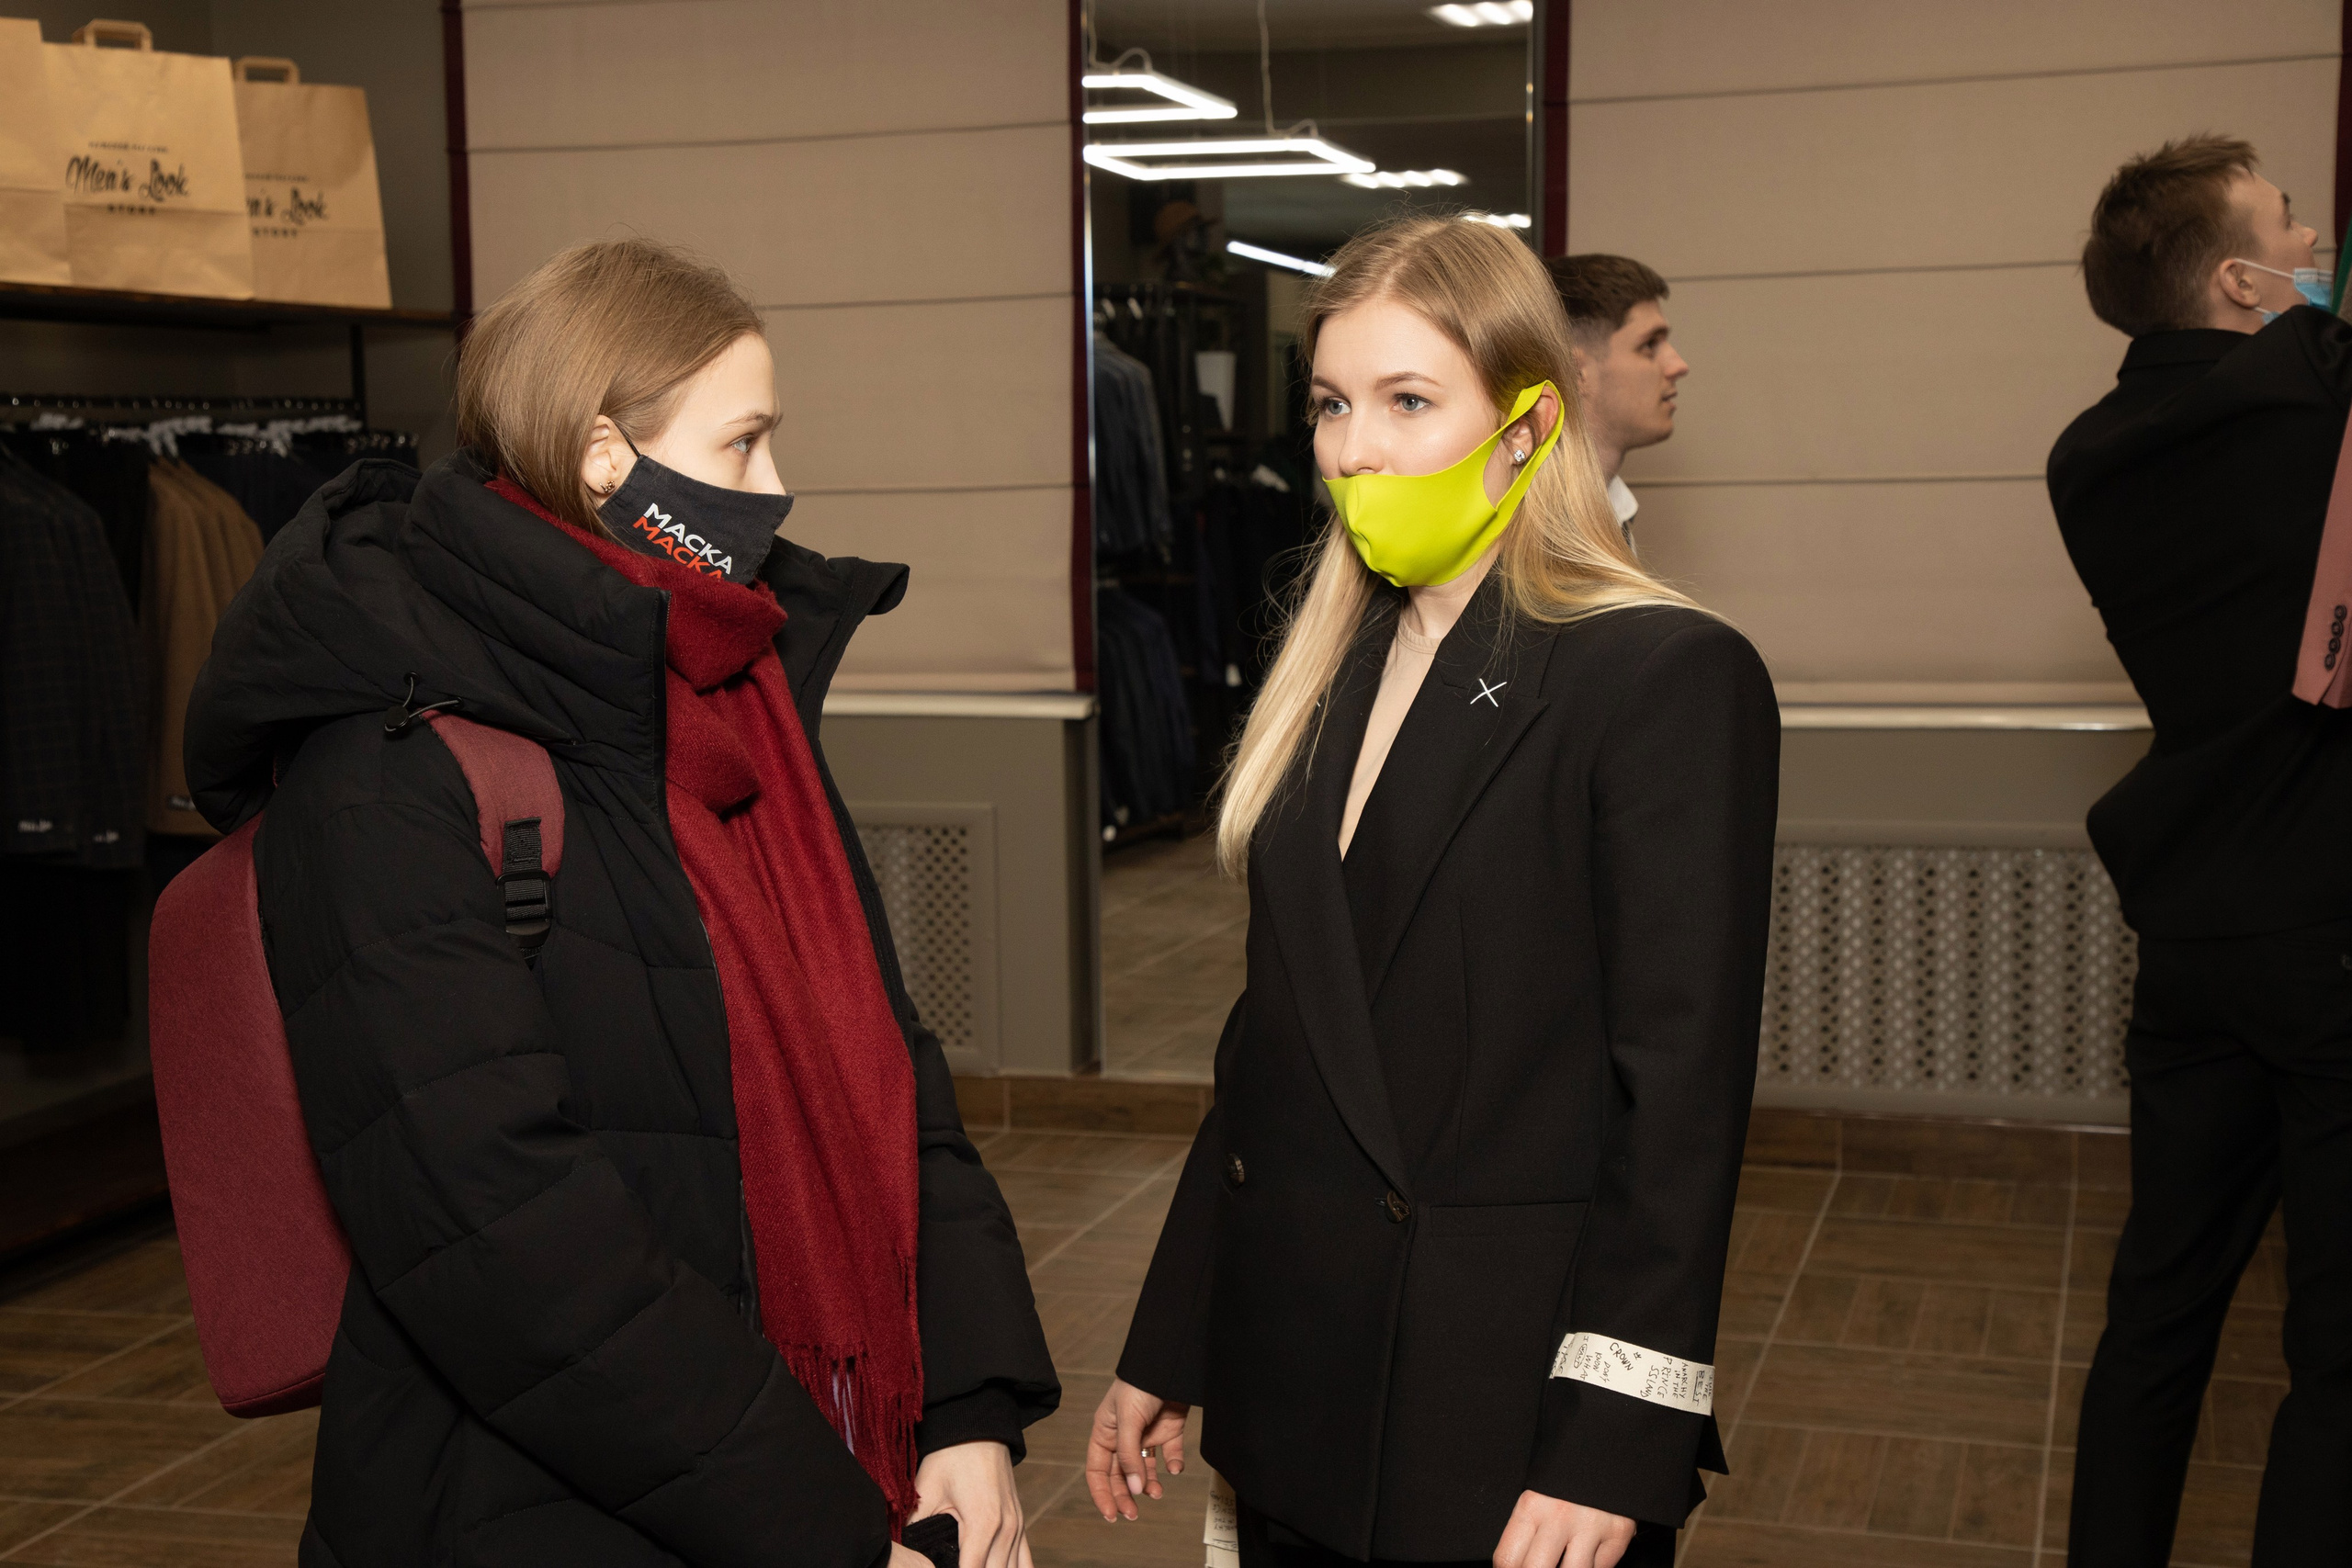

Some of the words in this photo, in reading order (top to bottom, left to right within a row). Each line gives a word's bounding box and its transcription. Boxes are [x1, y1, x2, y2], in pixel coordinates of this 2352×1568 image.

[138, 157, 189, 203] Look
[1580, 1354, 1593, 1381] WHAT
[1610, 1342, 1634, 1371] CROWN
[1692, 1370, 1705, 1406] BEST
